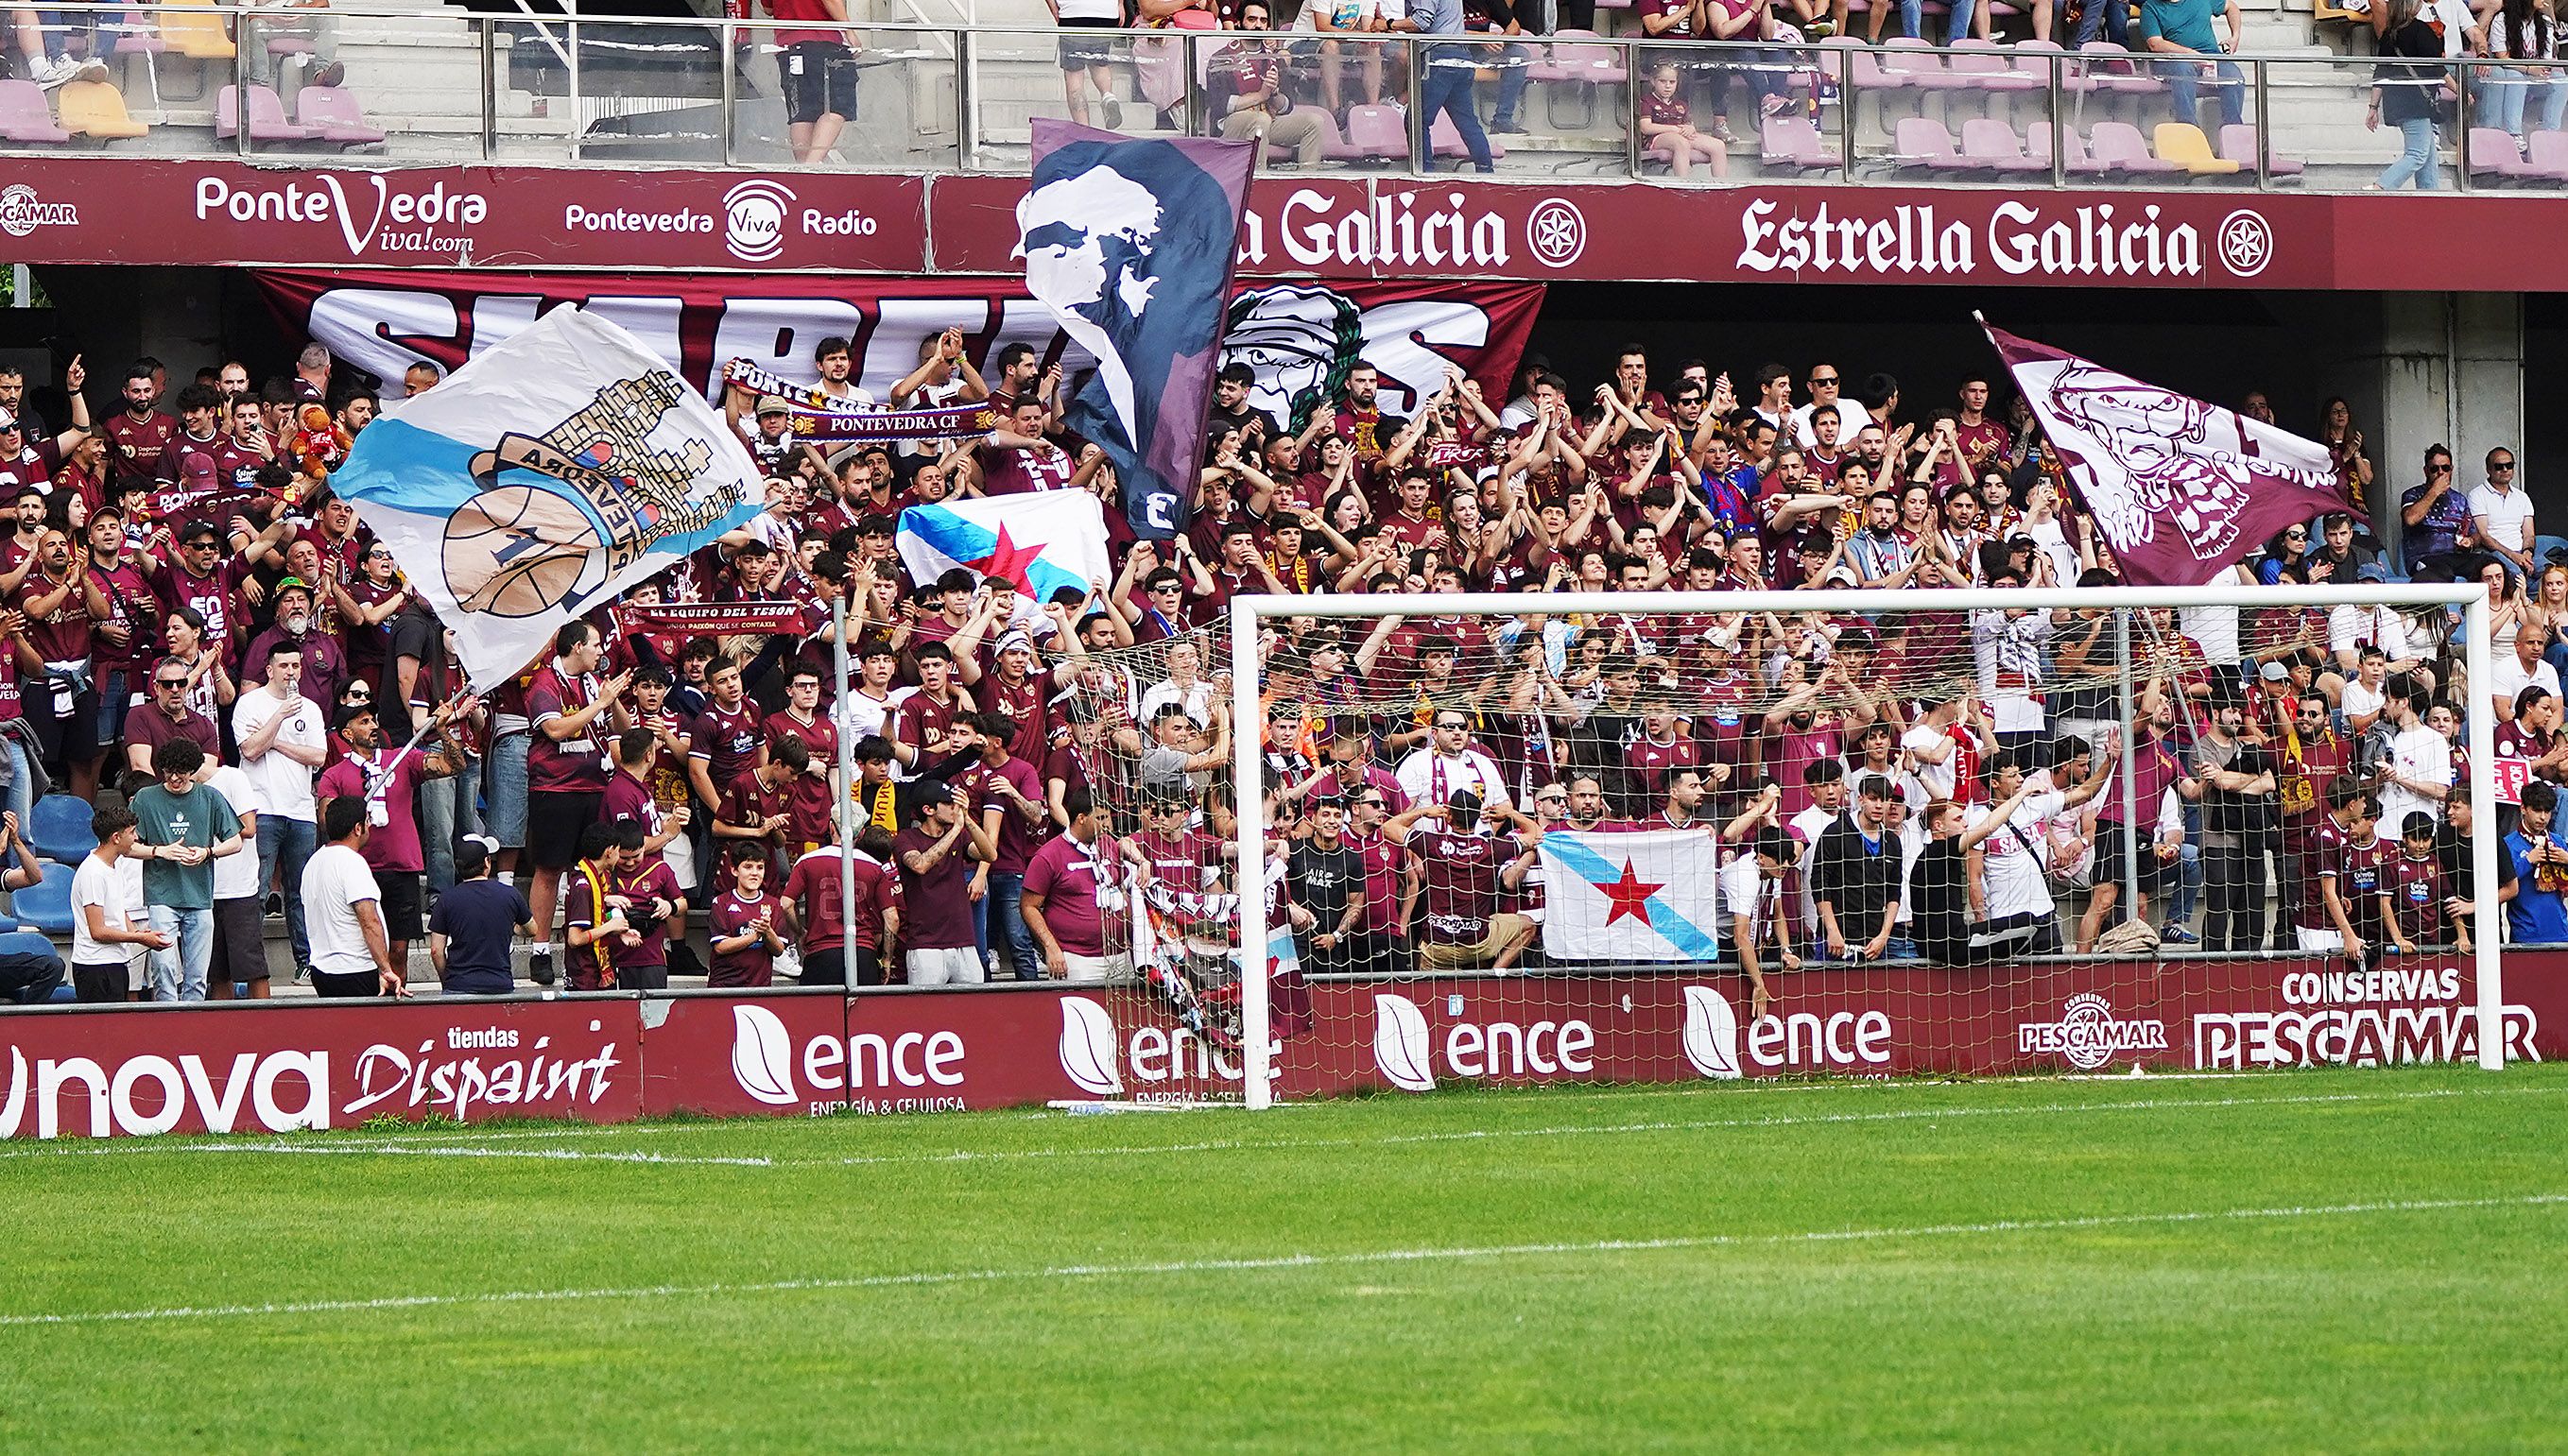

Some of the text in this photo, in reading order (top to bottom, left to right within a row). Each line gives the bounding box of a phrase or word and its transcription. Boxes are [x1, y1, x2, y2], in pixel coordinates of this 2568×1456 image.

[0, 203, 79, 225] CAMAR
[565, 204, 877, 235] Pontevedra Viva Radio
[1281, 189, 1510, 268] Galicia
[1736, 198, 2202, 277] Estrella Galicia
[831, 415, 960, 432] PONTEVEDRA CF
[650, 605, 797, 619] EL EQUIPO DEL TESÓN
[687, 622, 715, 630] PAIXÓN
[741, 621, 777, 629] CONTAXIA
[1998, 823, 2042, 853] SASA
[1306, 876, 1334, 889] MAX
[1308, 868, 1324, 879] AIR
[2283, 968, 2460, 1004] CONSERVAS
[2064, 993, 2111, 1011] CONSERVAS
[447, 1026, 520, 1050] tiendas
[1446, 1019, 1594, 1075] ence
[1749, 1011, 1891, 1066] ence
[2019, 1019, 2169, 1053] PESCAMAR
[342, 1019, 622, 1122] Dispaint
[804, 1032, 965, 1089] ence
